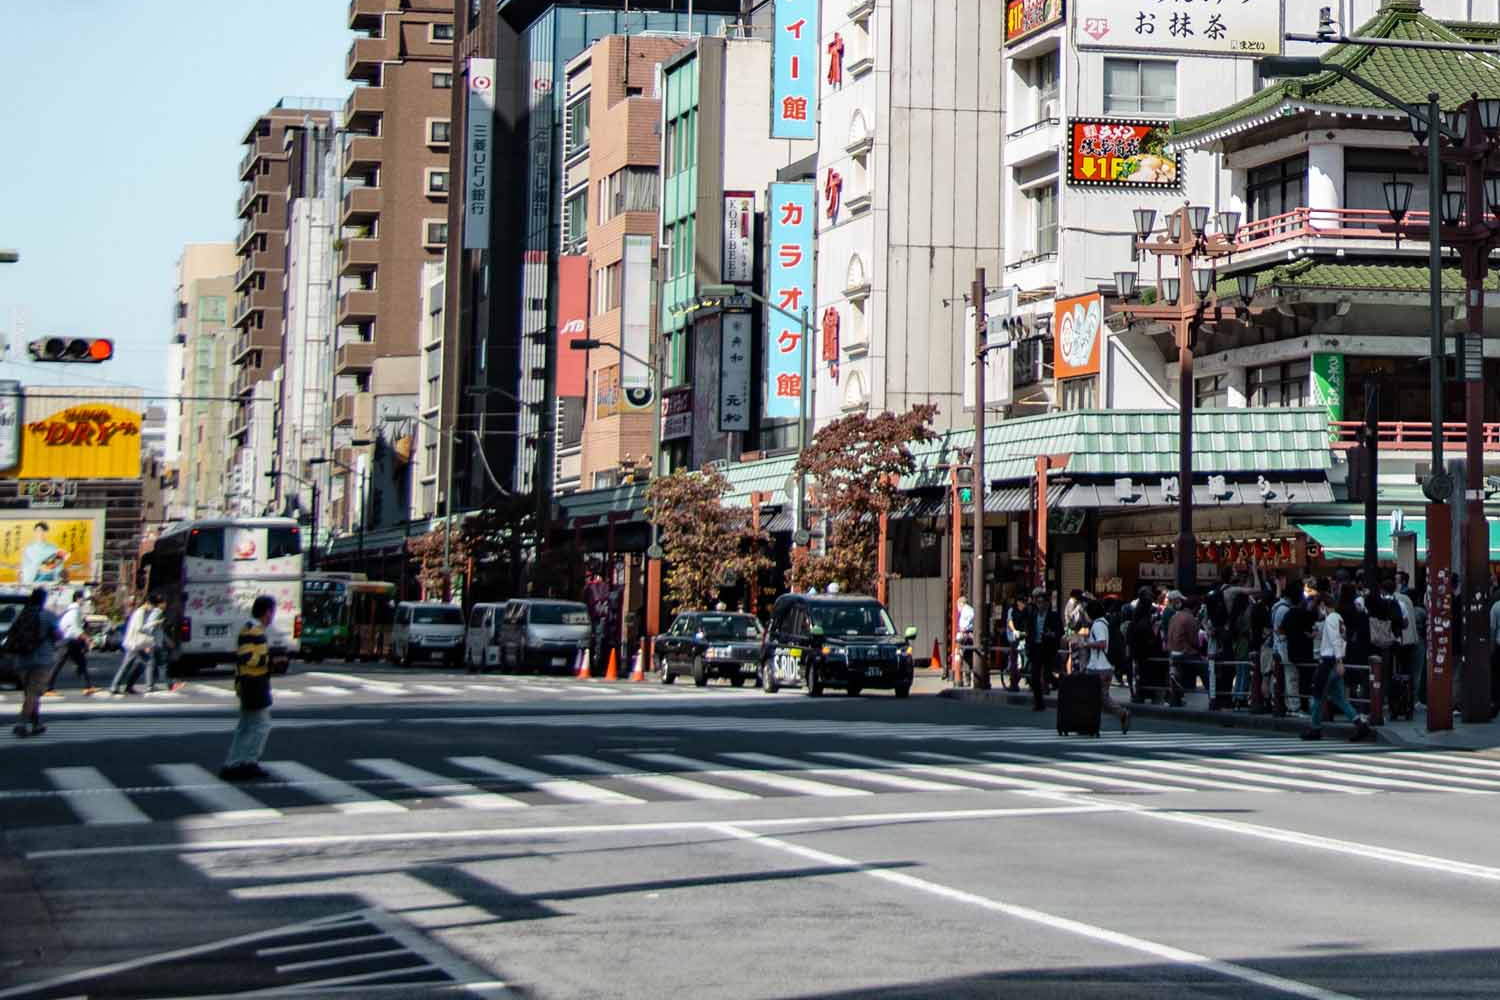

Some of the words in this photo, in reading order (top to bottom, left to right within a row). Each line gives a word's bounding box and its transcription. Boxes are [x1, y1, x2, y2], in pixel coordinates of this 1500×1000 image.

[1135, 11, 1227, 41] お抹茶
[1097, 157, 1124, 180] 1F
[776, 201, 803, 398] カラオケ館
[561, 319, 586, 334] JTB
